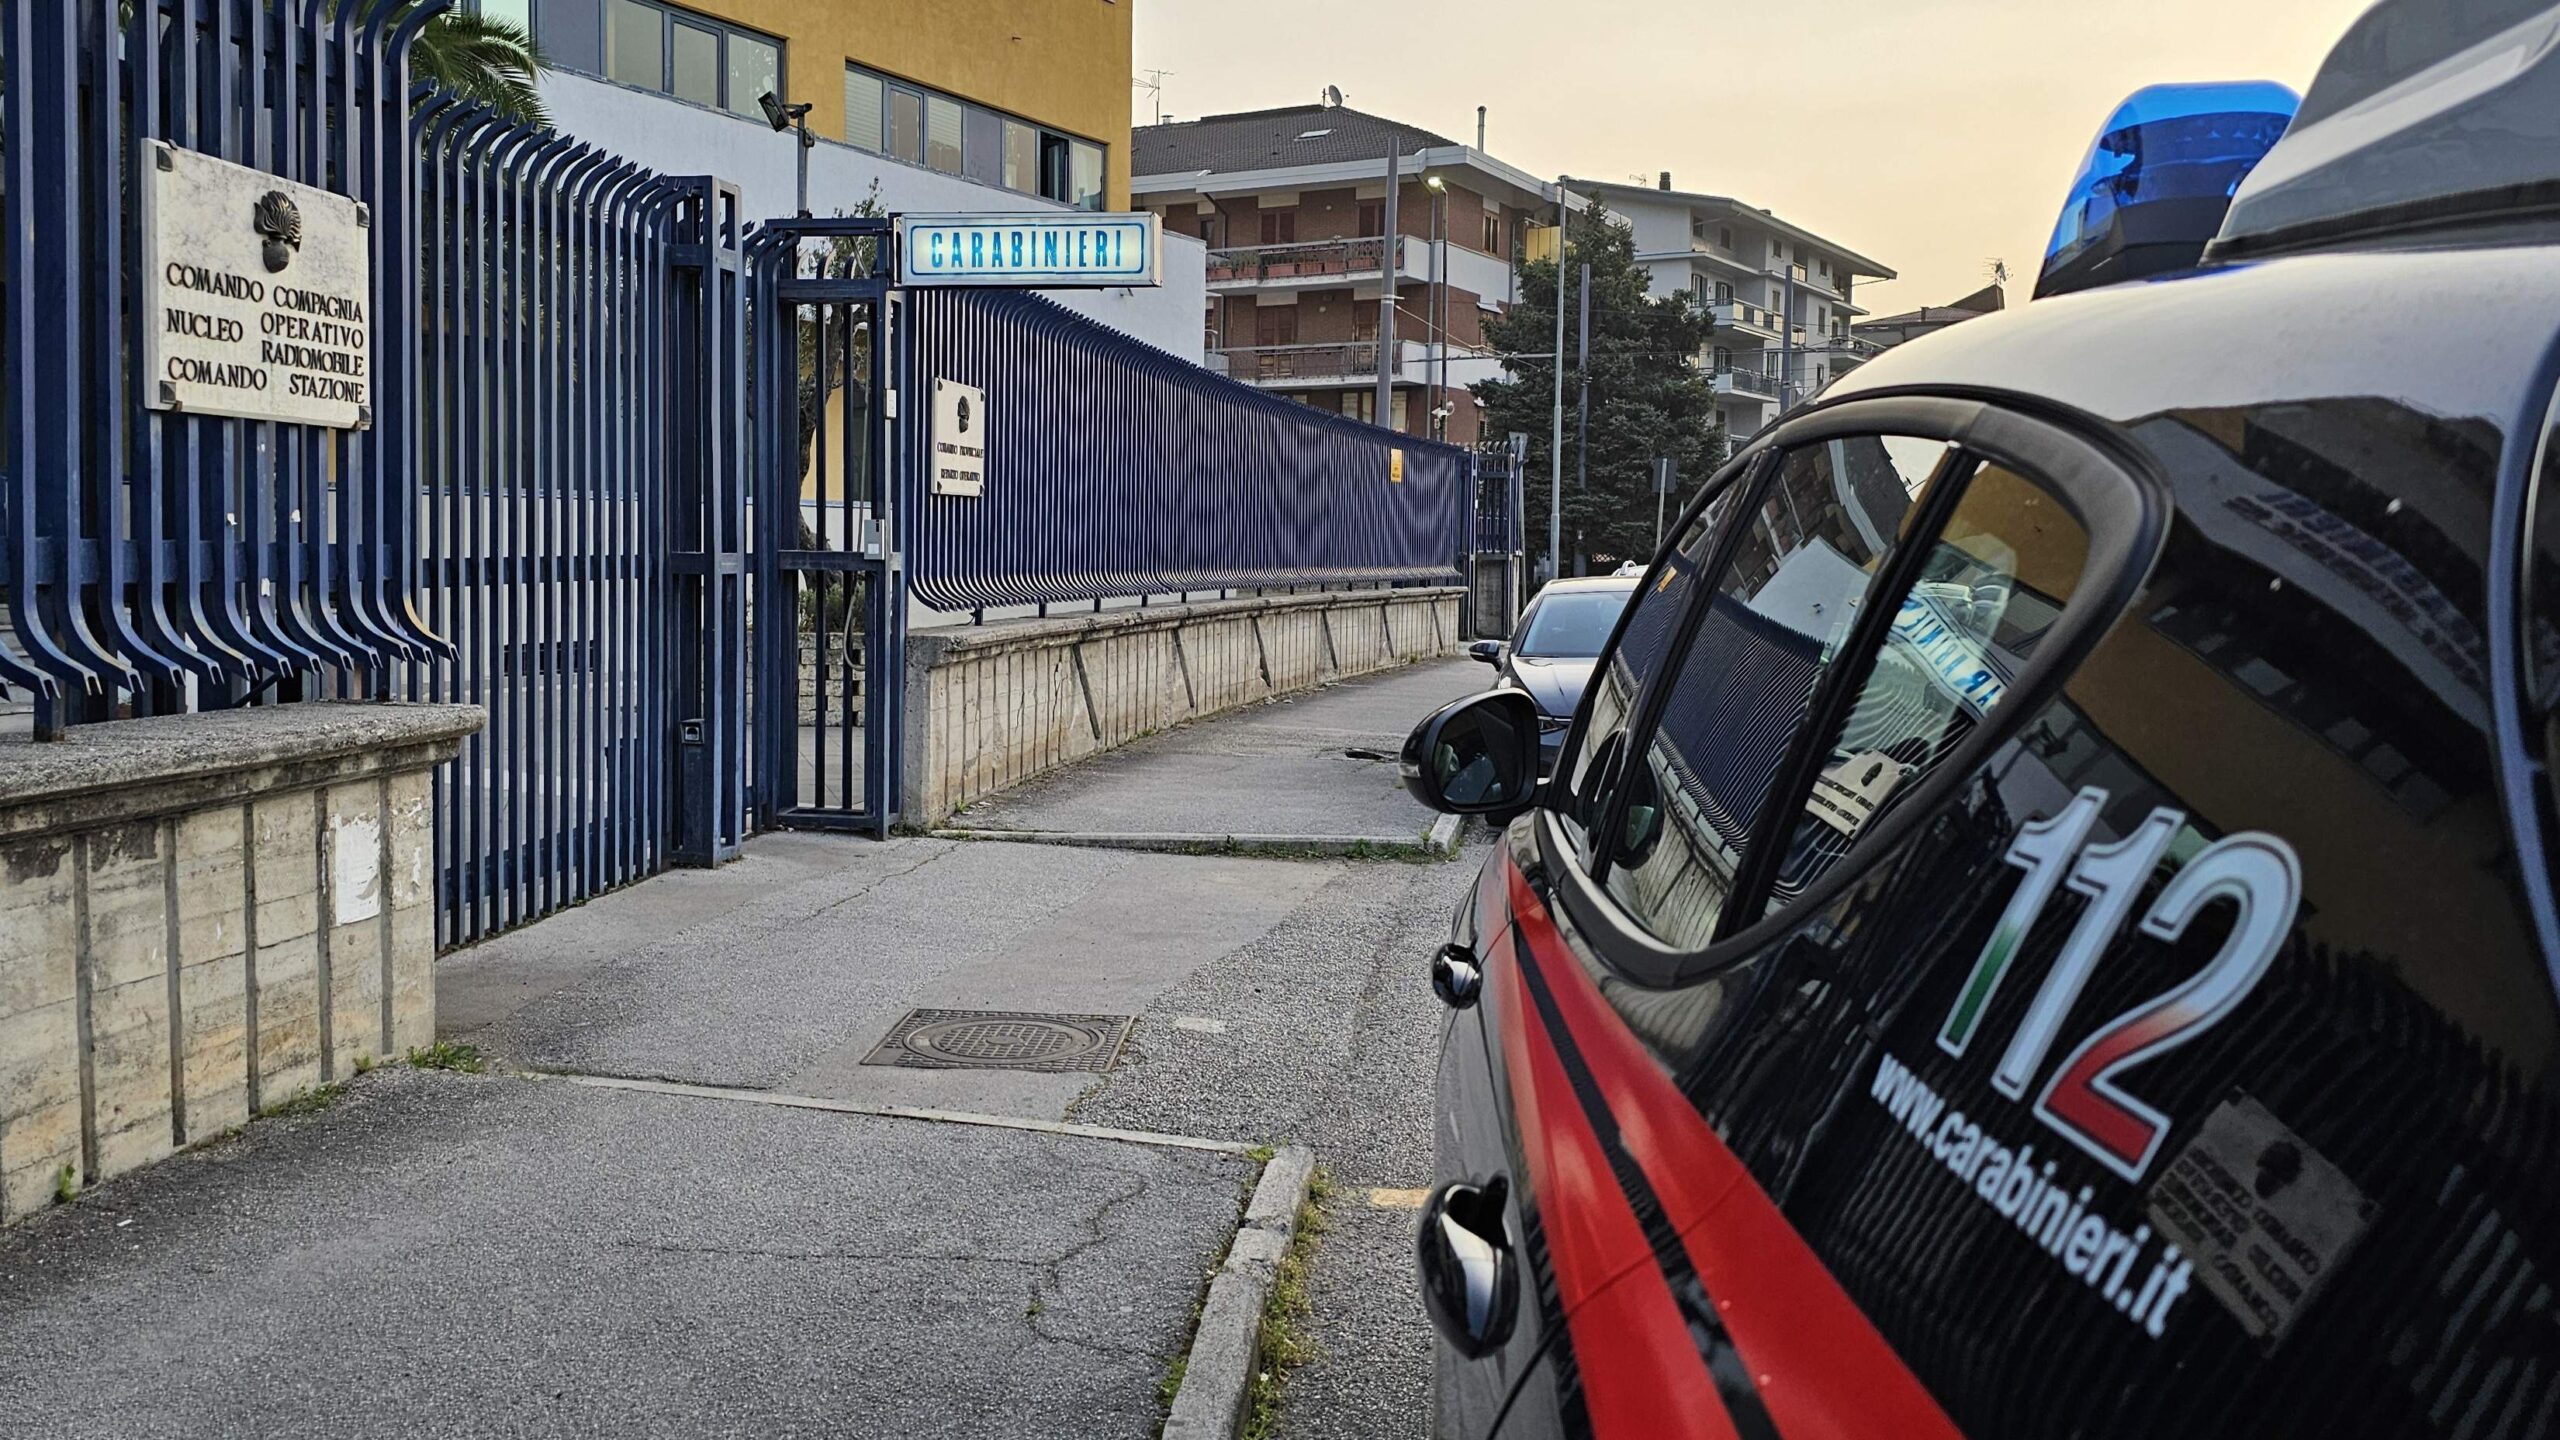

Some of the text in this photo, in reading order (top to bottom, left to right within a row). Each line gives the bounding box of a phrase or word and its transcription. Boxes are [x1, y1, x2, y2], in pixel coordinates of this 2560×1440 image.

[931, 230, 1121, 268] CARABINIERI
[166, 262, 363, 323] COMANDO COMPAGNIA
[166, 308, 364, 349] NUCLEO OPERATIVO
[167, 356, 365, 404] COMANDO STAZIONE
[261, 340, 364, 377] RADIOMOBILE
[1937, 786, 2302, 1184] 112
[1870, 1053, 2194, 1339] www.carabinieri.it
